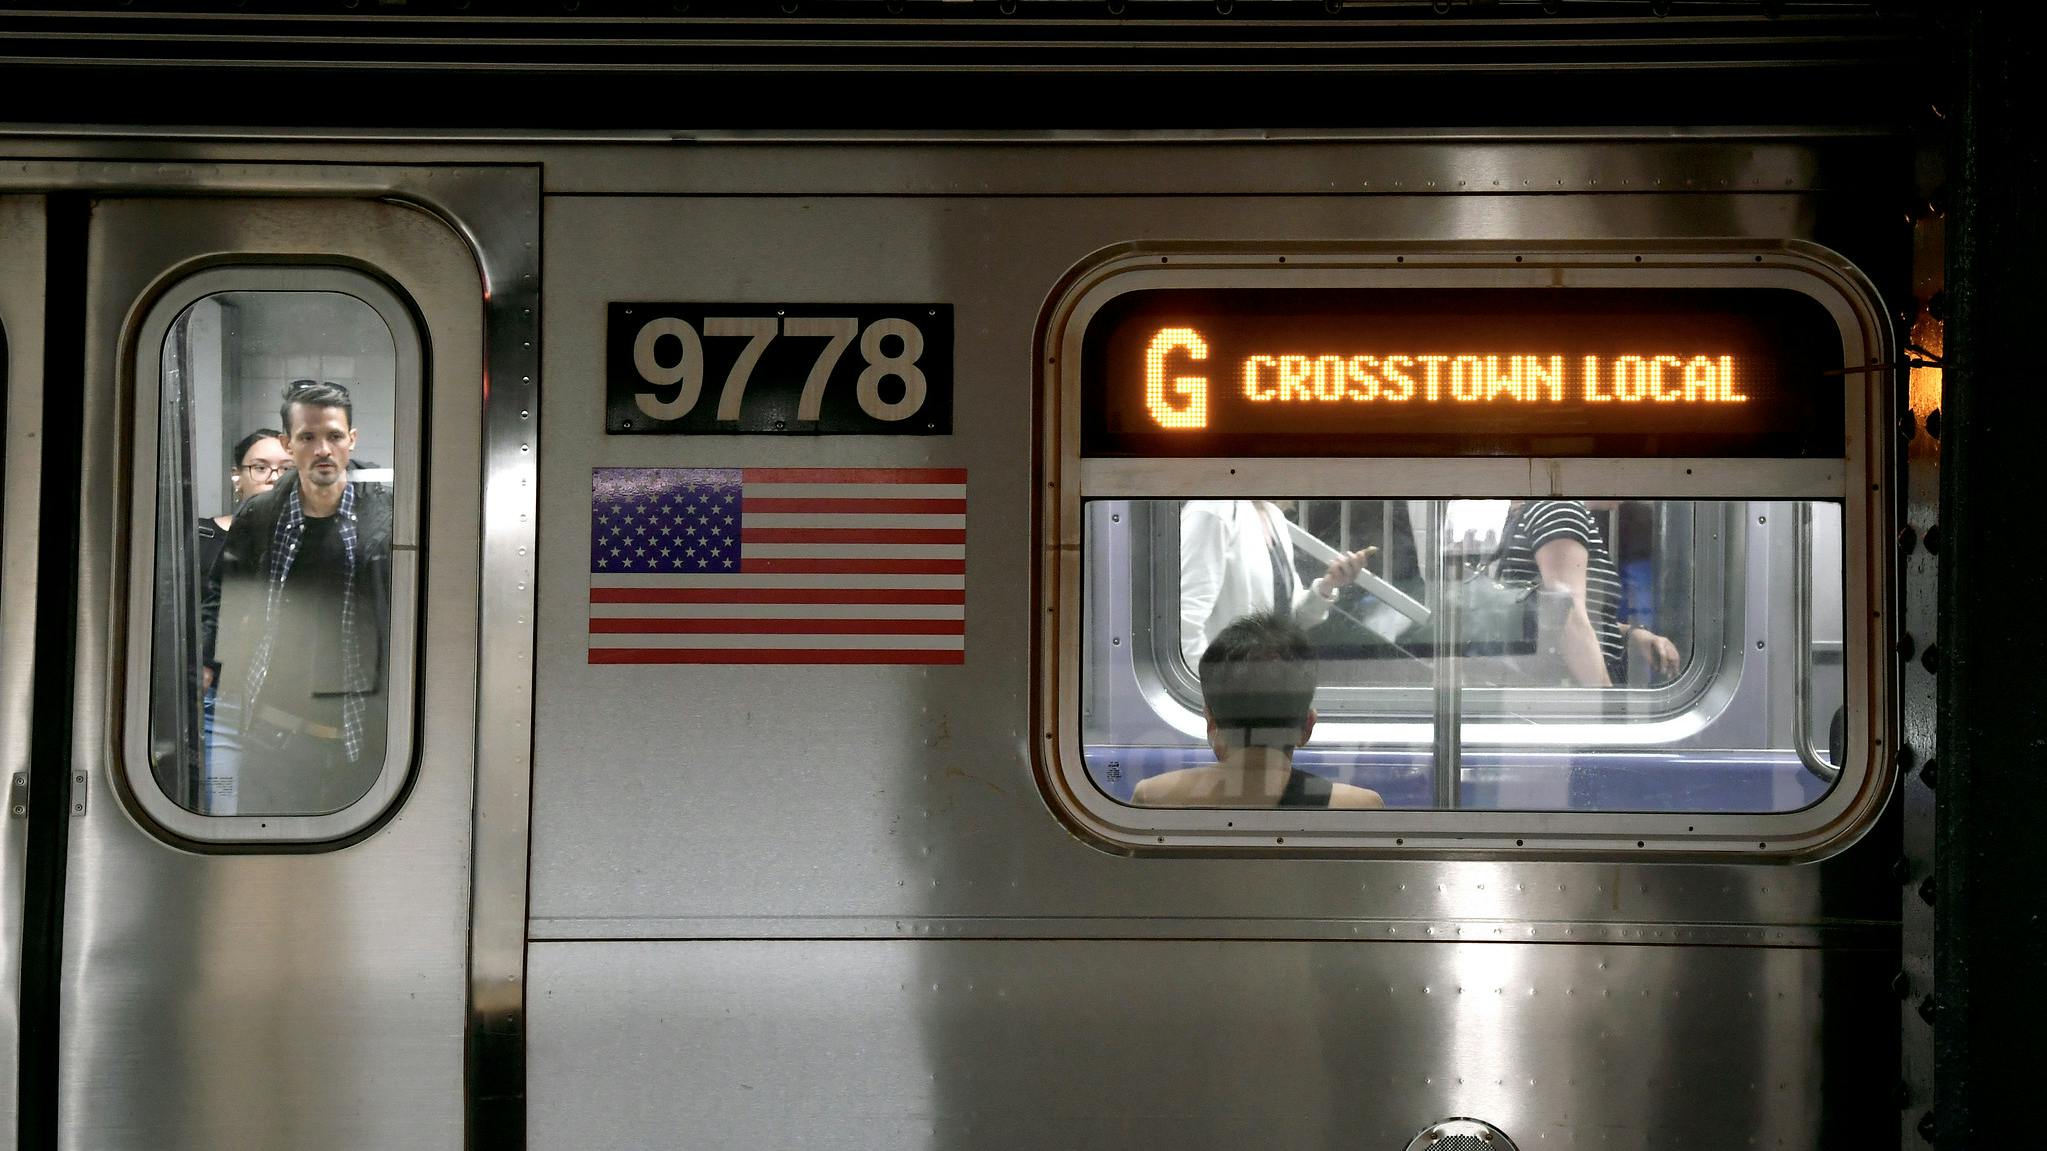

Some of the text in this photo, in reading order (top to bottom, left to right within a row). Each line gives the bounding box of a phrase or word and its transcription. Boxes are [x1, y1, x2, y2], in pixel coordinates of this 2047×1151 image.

[633, 317, 927, 421] 9778
[1146, 327, 1747, 429] G CROSSTOWN LOCAL
